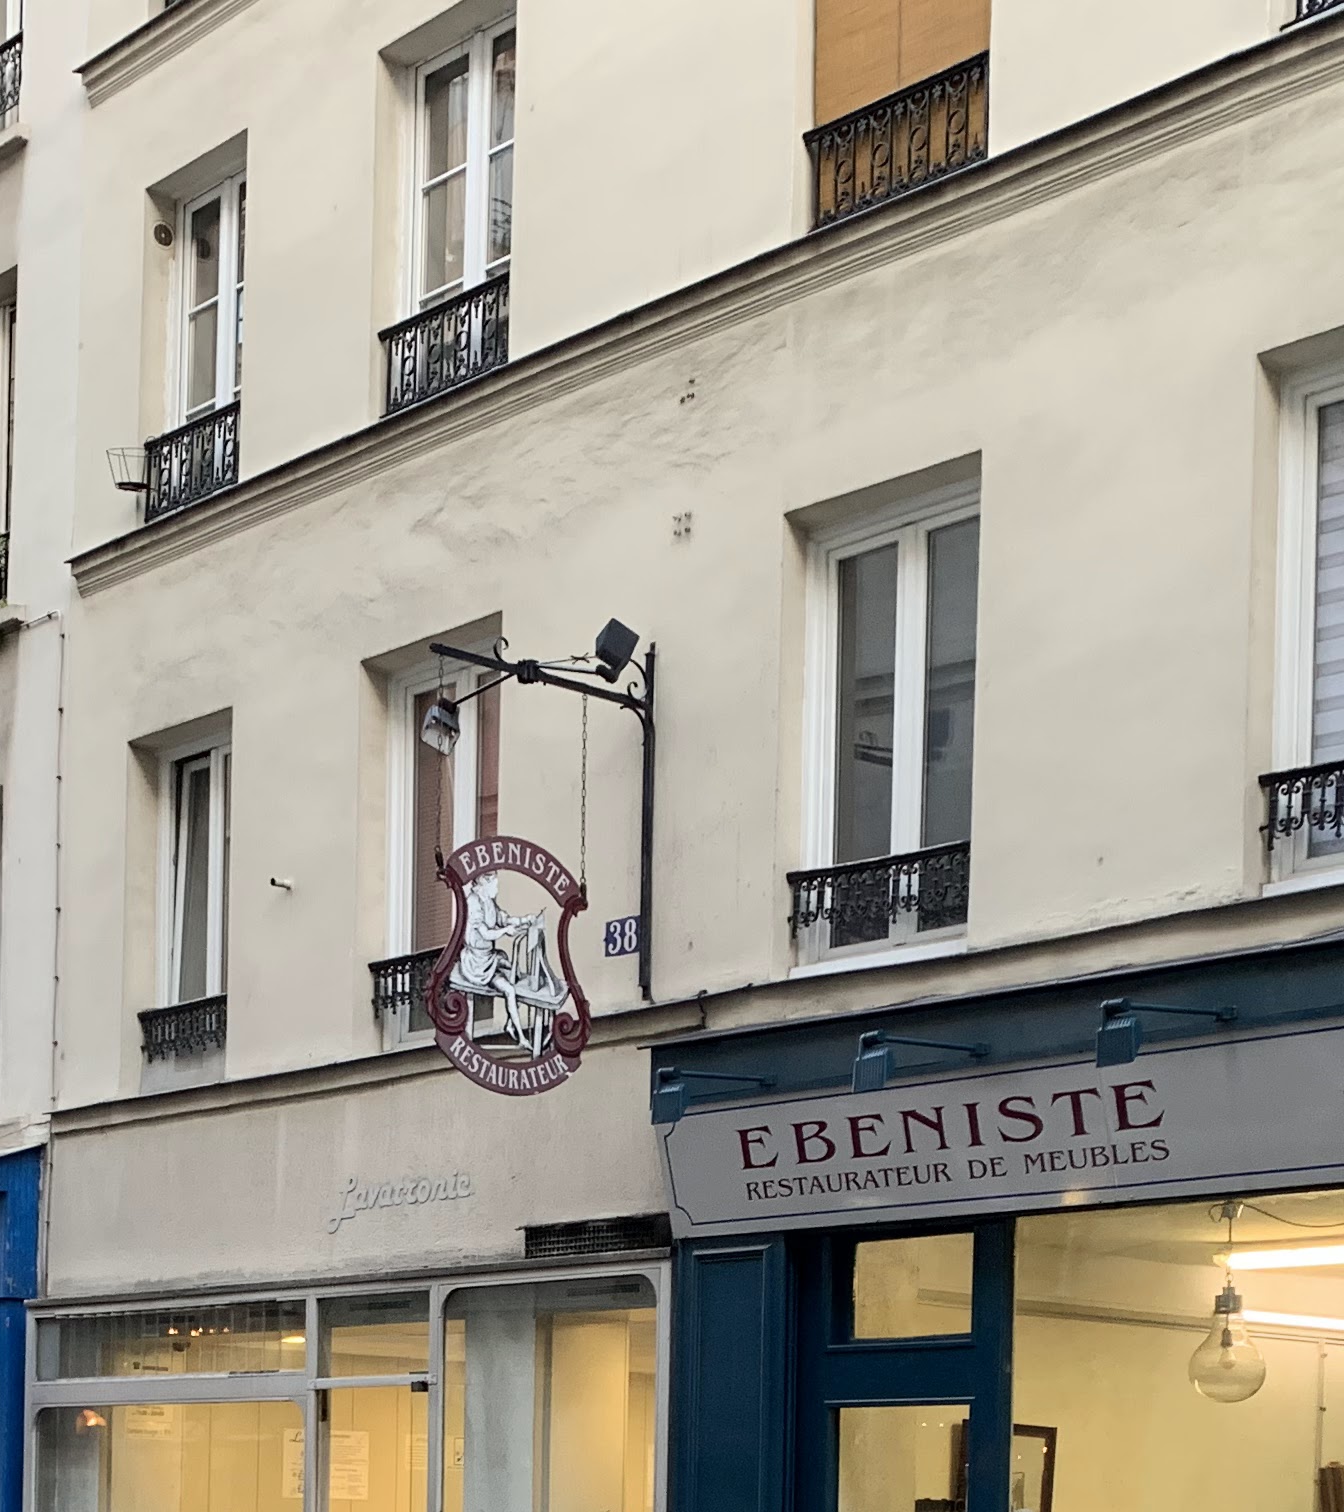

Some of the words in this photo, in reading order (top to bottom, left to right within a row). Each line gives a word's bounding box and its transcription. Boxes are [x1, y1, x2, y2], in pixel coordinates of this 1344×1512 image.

[458, 841, 570, 897] EBENISTE
[608, 918, 638, 955] 38
[449, 1035, 569, 1090] RESTAURATEUR
[735, 1079, 1166, 1171] EBENISTE
[745, 1161, 953, 1201] RESTAURATEUR
[967, 1156, 1008, 1180] DE
[1024, 1138, 1170, 1175] MEUBLES
